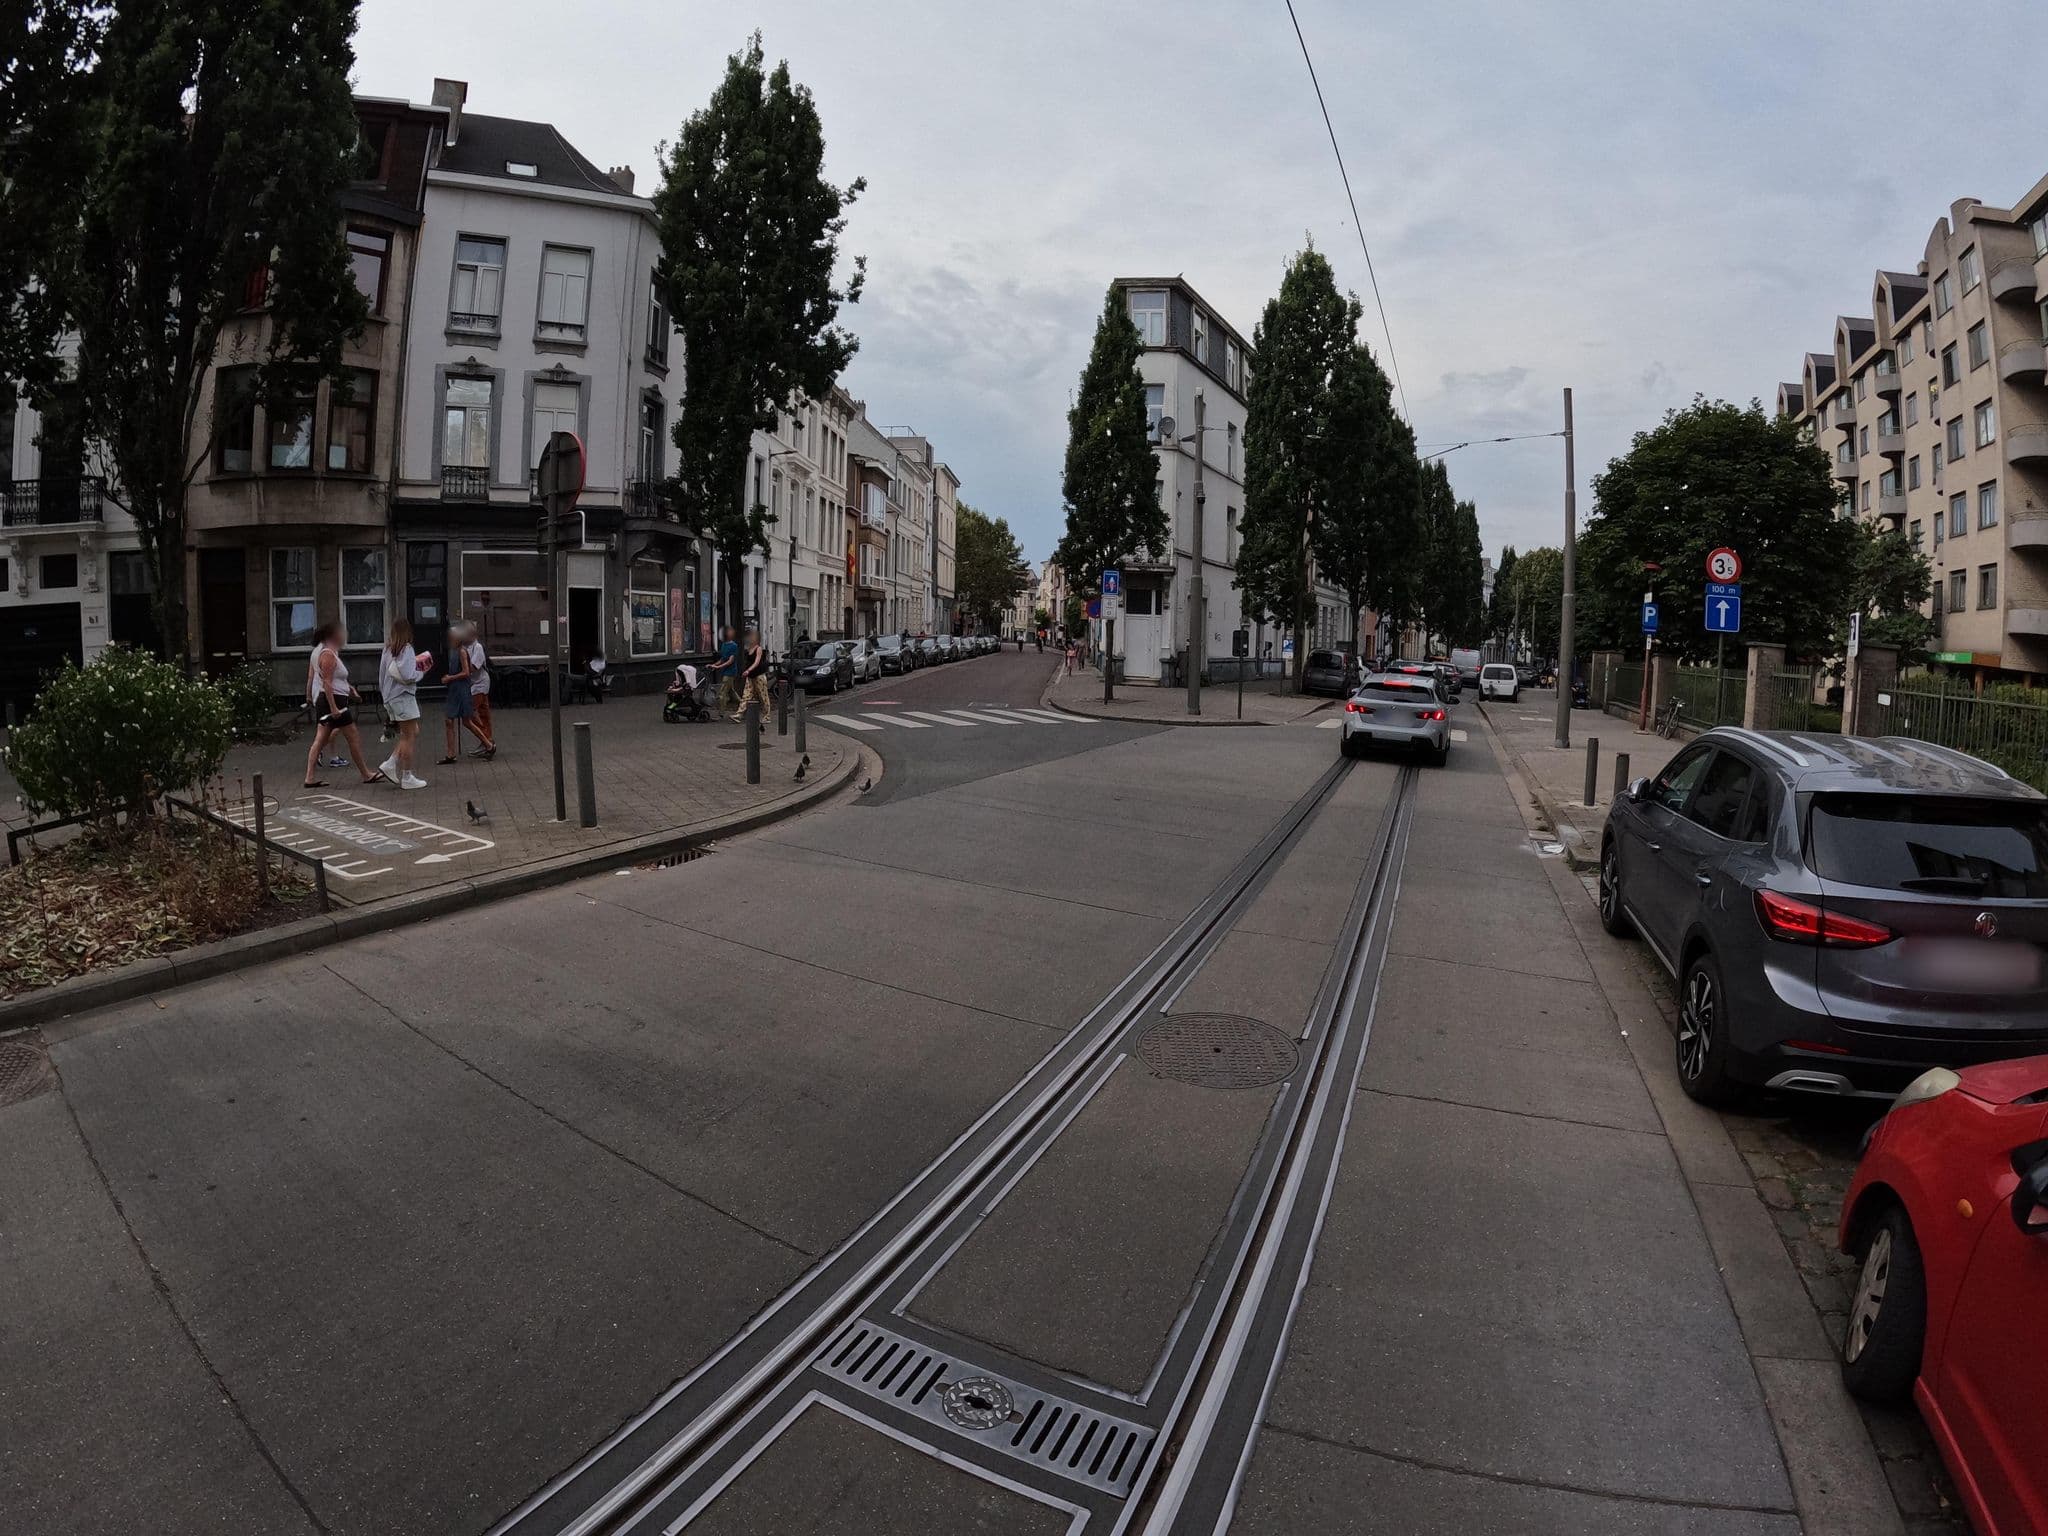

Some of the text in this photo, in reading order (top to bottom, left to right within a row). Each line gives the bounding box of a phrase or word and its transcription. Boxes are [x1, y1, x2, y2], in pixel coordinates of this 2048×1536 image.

[1712, 585, 1736, 596] 100 m
[1645, 606, 1657, 623] P
